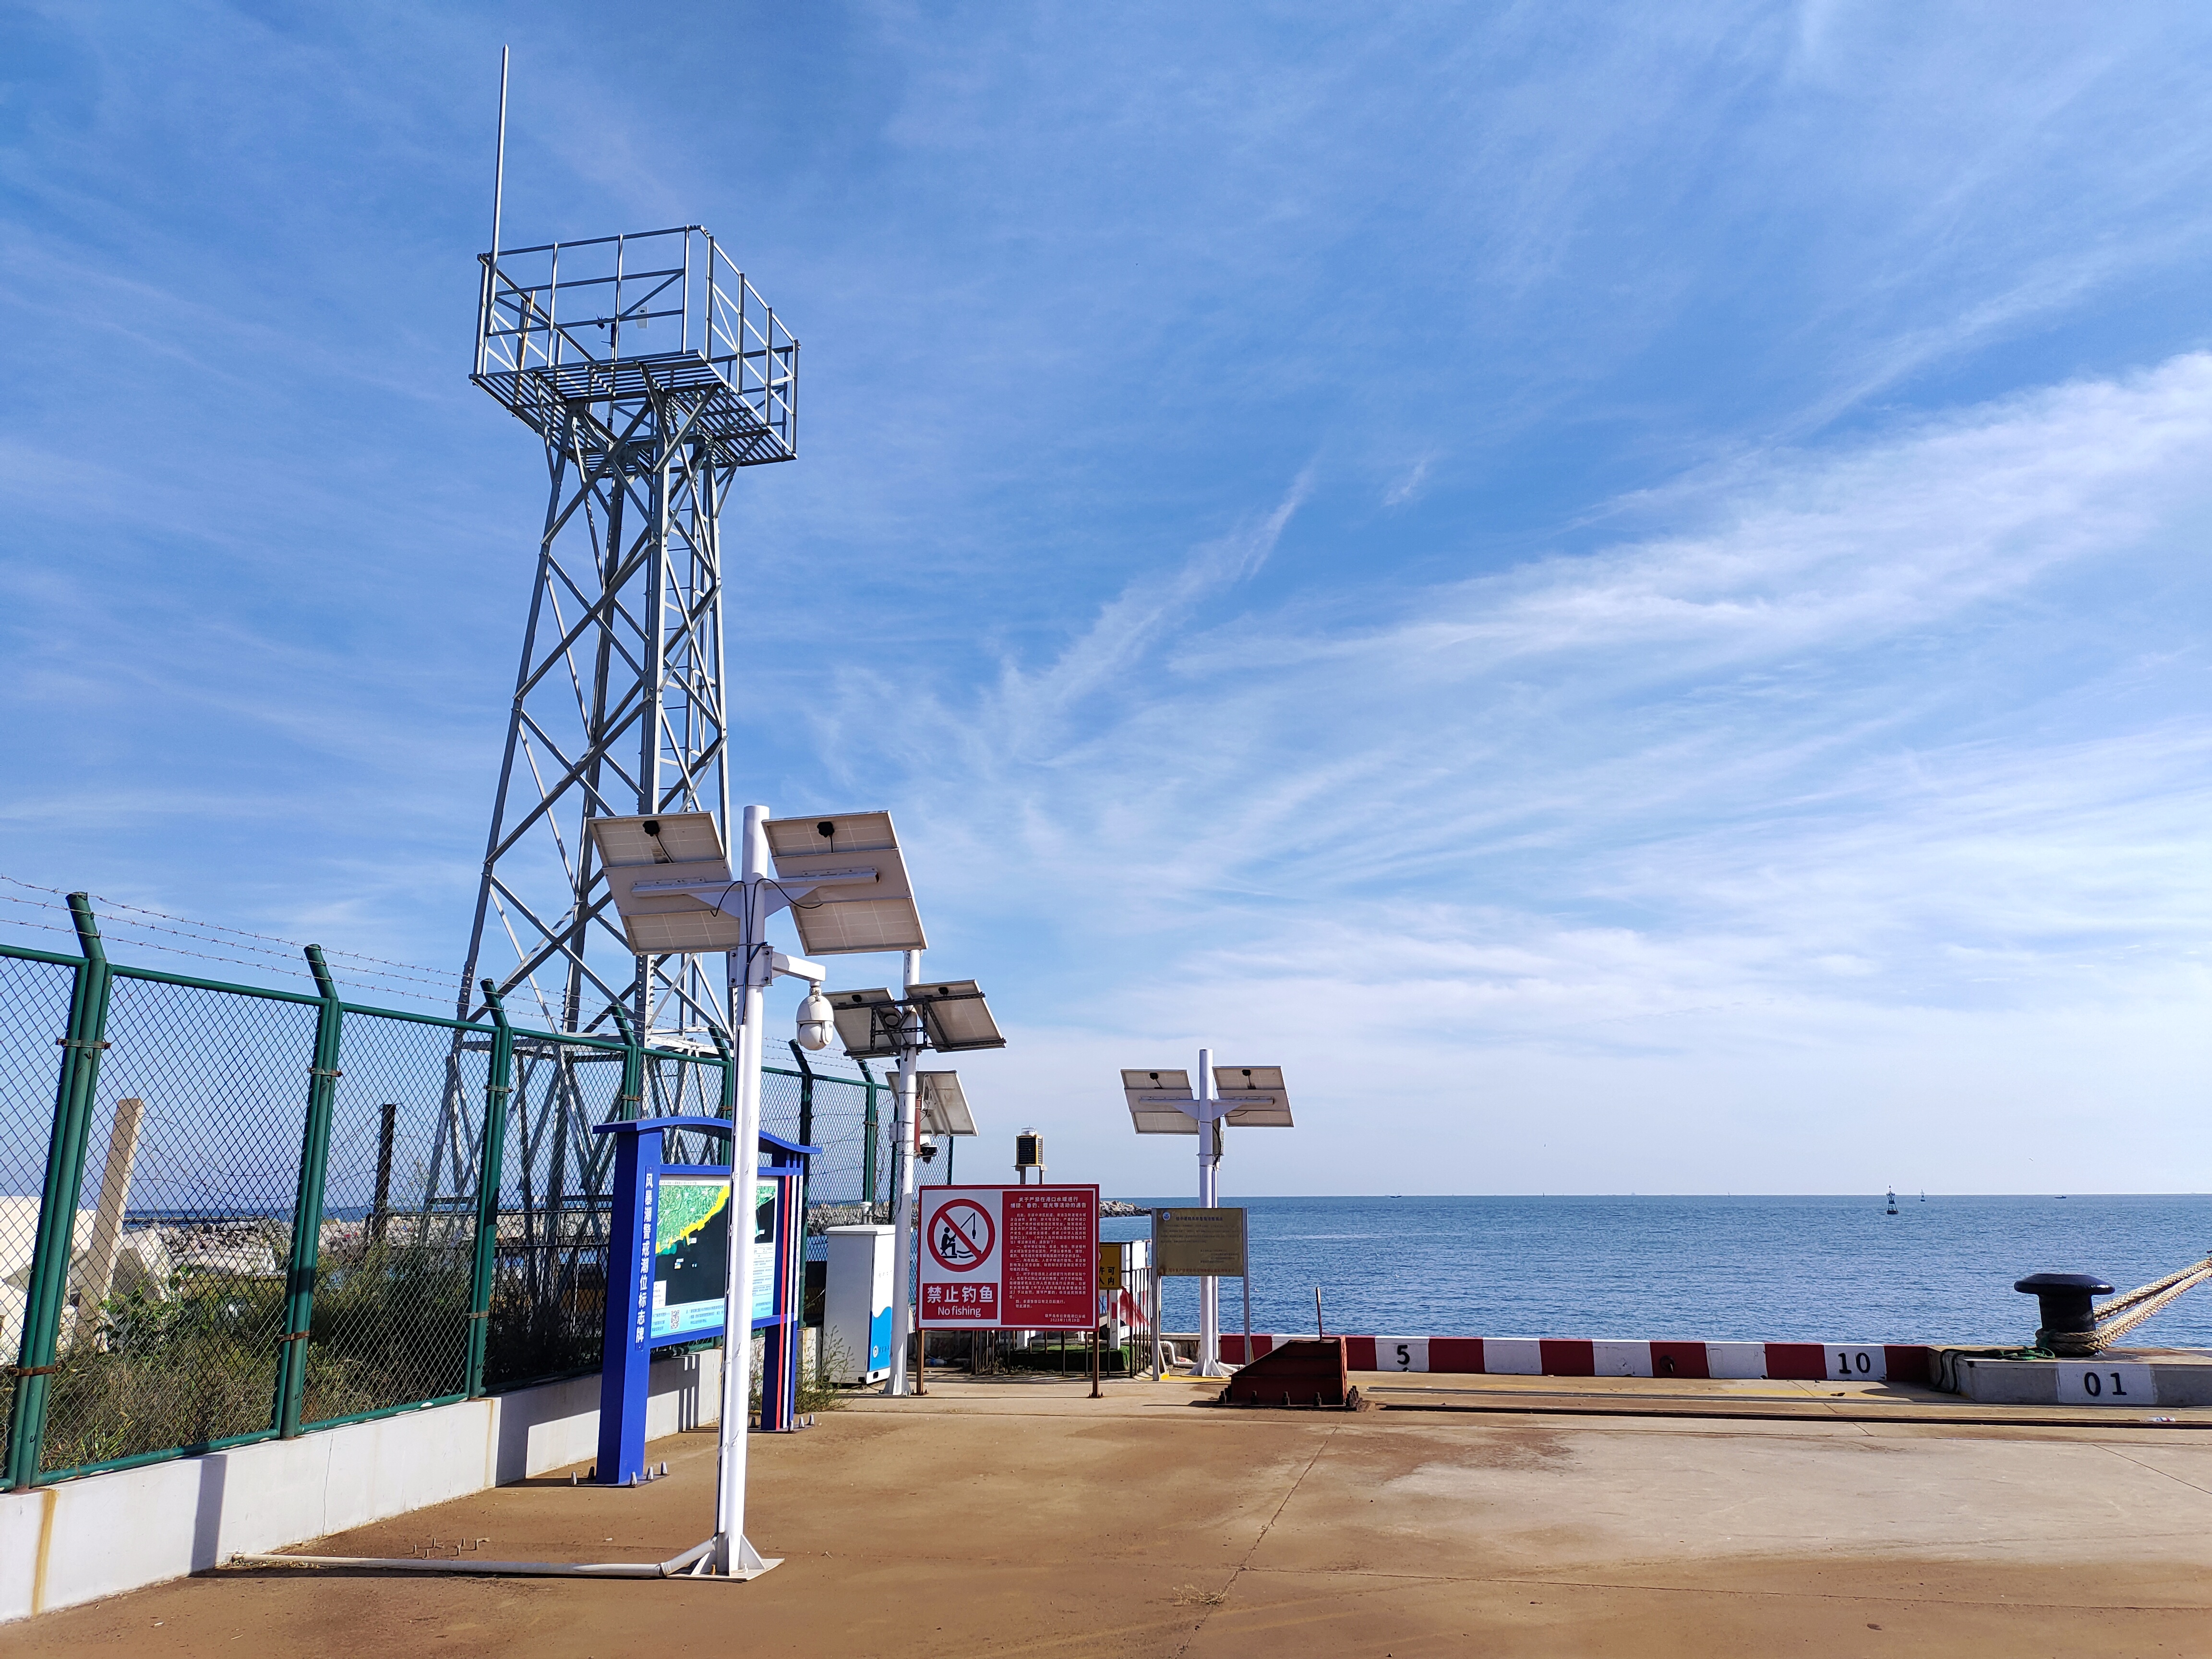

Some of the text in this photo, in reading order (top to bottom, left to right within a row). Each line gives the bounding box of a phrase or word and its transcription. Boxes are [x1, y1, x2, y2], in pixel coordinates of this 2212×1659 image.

[636, 1173, 653, 1344] 风暴潮警戒潮位标志牌
[927, 1286, 994, 1304] 禁止钓鱼
[938, 1305, 981, 1318] No fishing
[1396, 1344, 1410, 1365] 5
[1838, 1352, 1871, 1374] 10
[2083, 1371, 2128, 1397] 01
